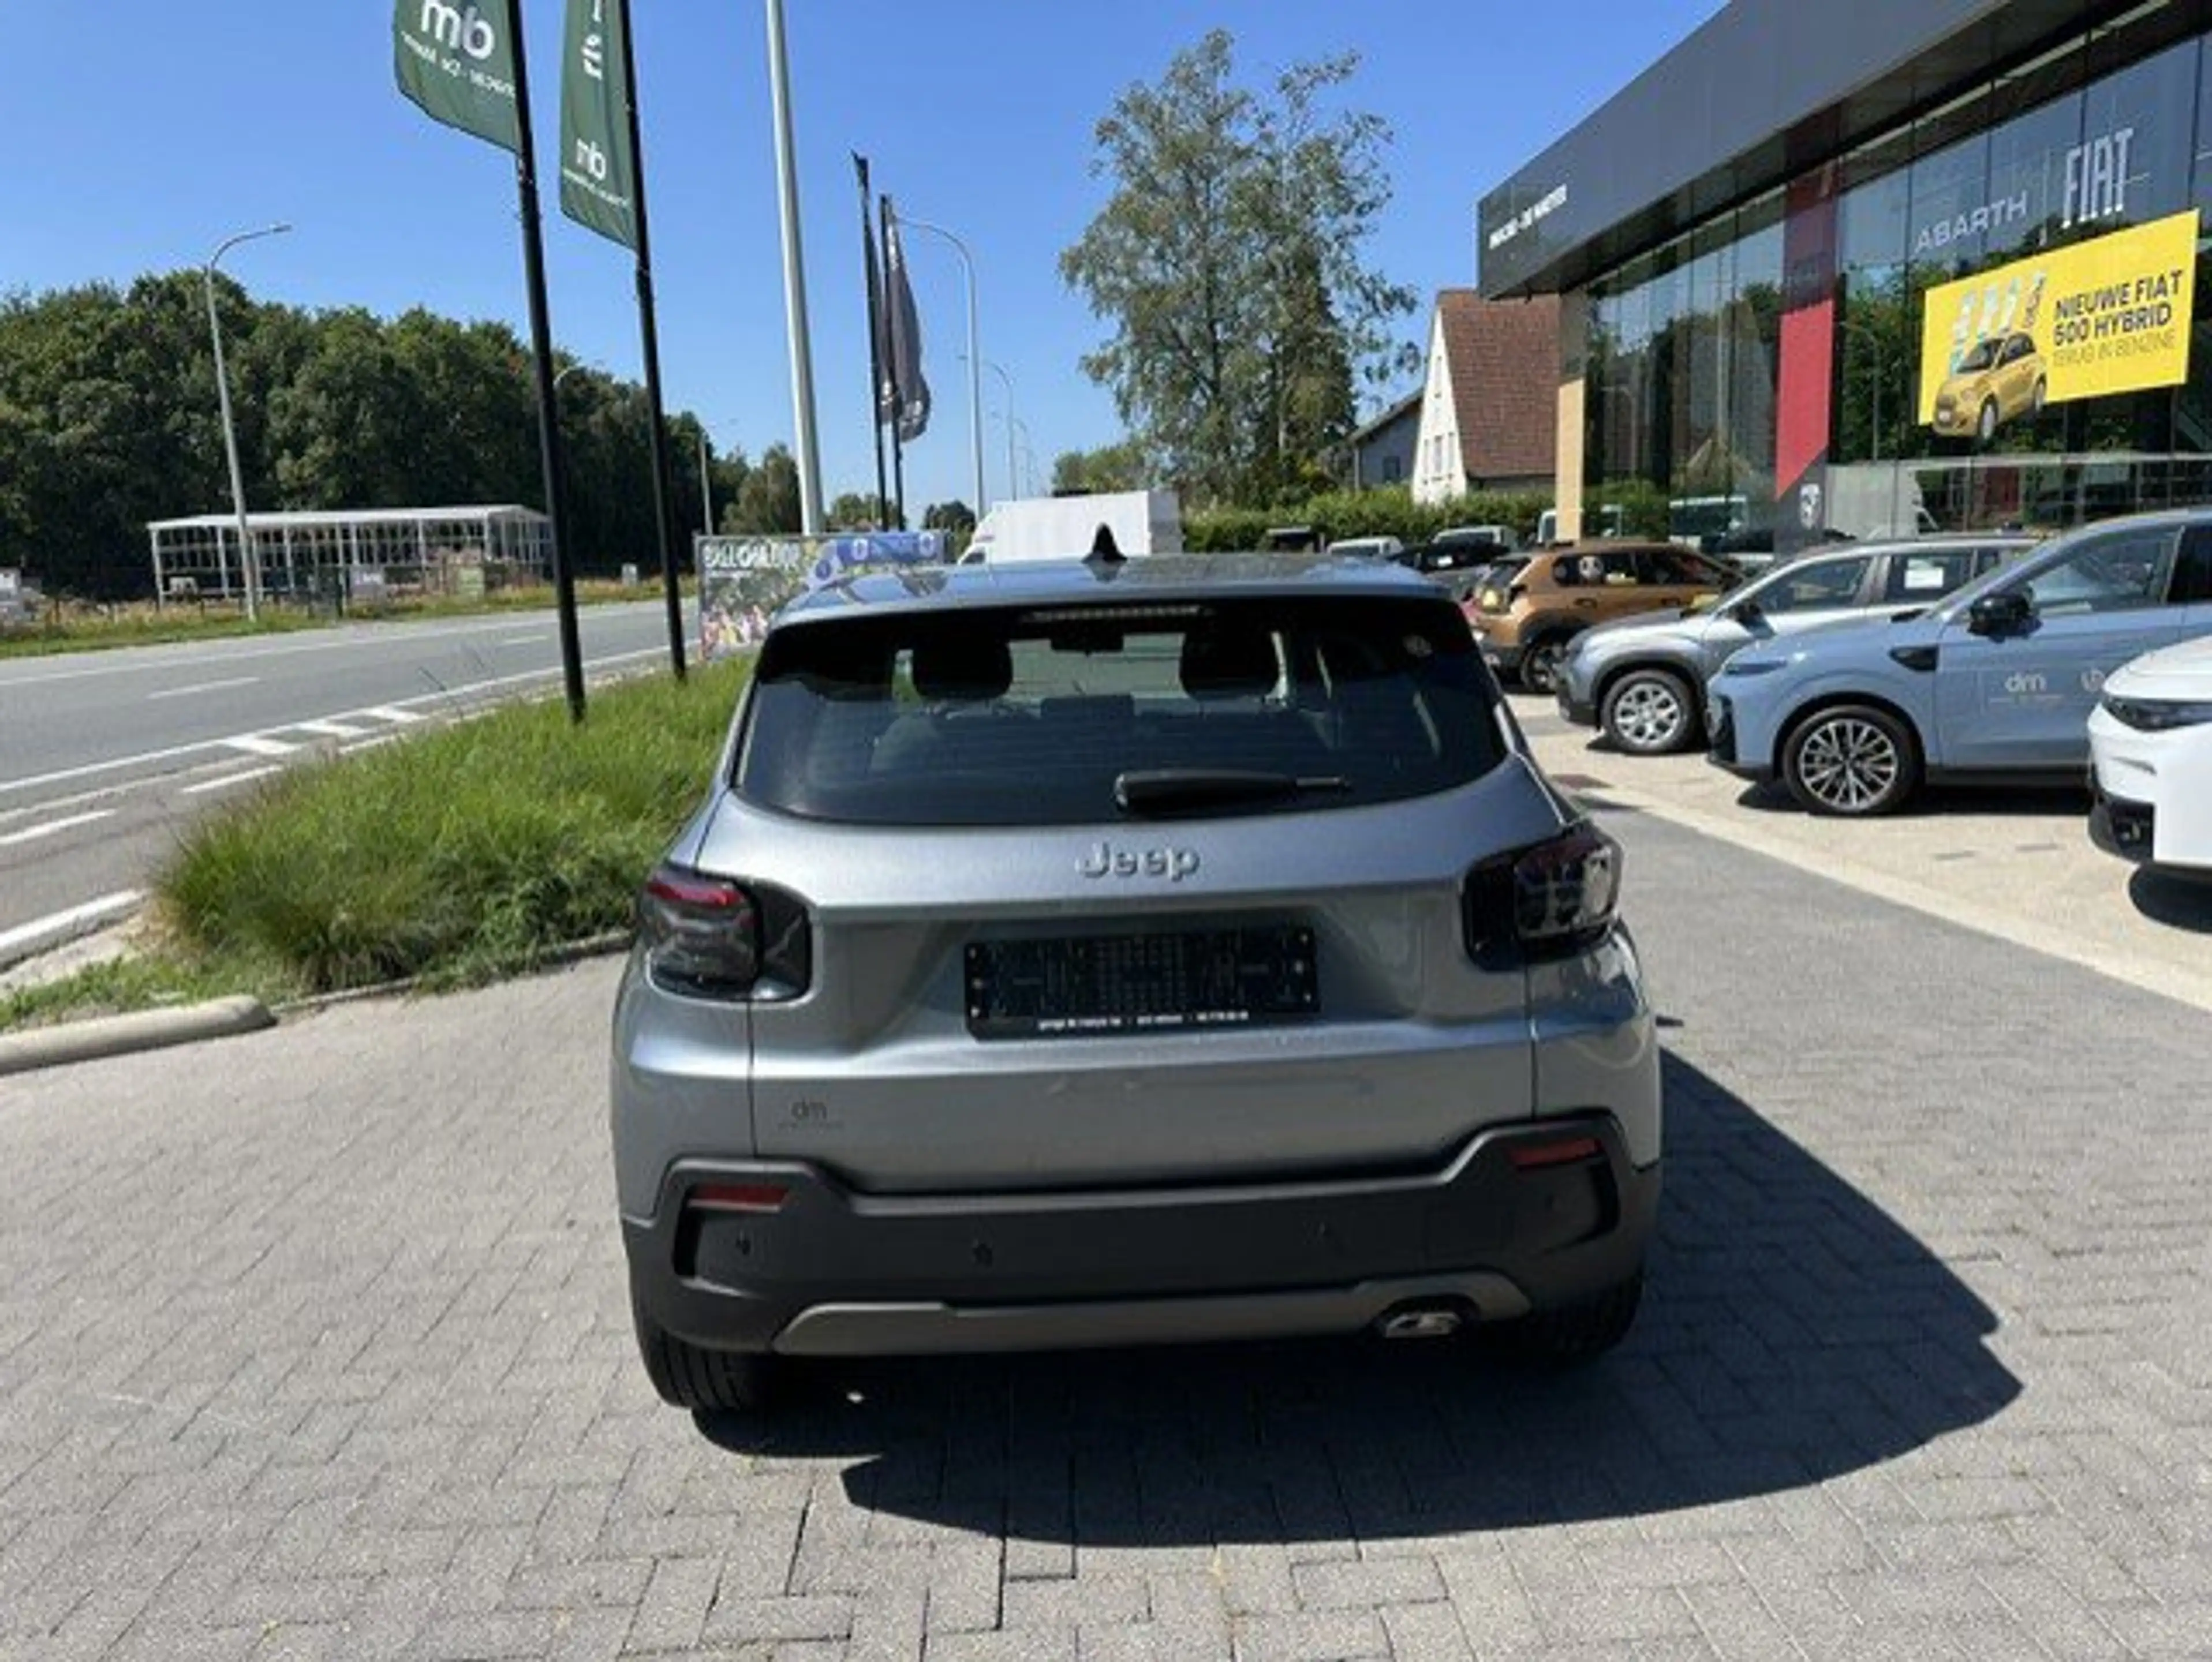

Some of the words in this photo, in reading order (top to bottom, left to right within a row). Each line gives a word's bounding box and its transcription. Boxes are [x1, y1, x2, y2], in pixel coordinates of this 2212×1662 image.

[2062, 128, 2133, 230] FIAT
[1915, 189, 2027, 254] ABARTH
[2054, 282, 2131, 321] NIEUWE
[2135, 269, 2183, 302] FIAT
[2094, 301, 2172, 339] HYBRID
[1074, 842, 1201, 882] Jeep
